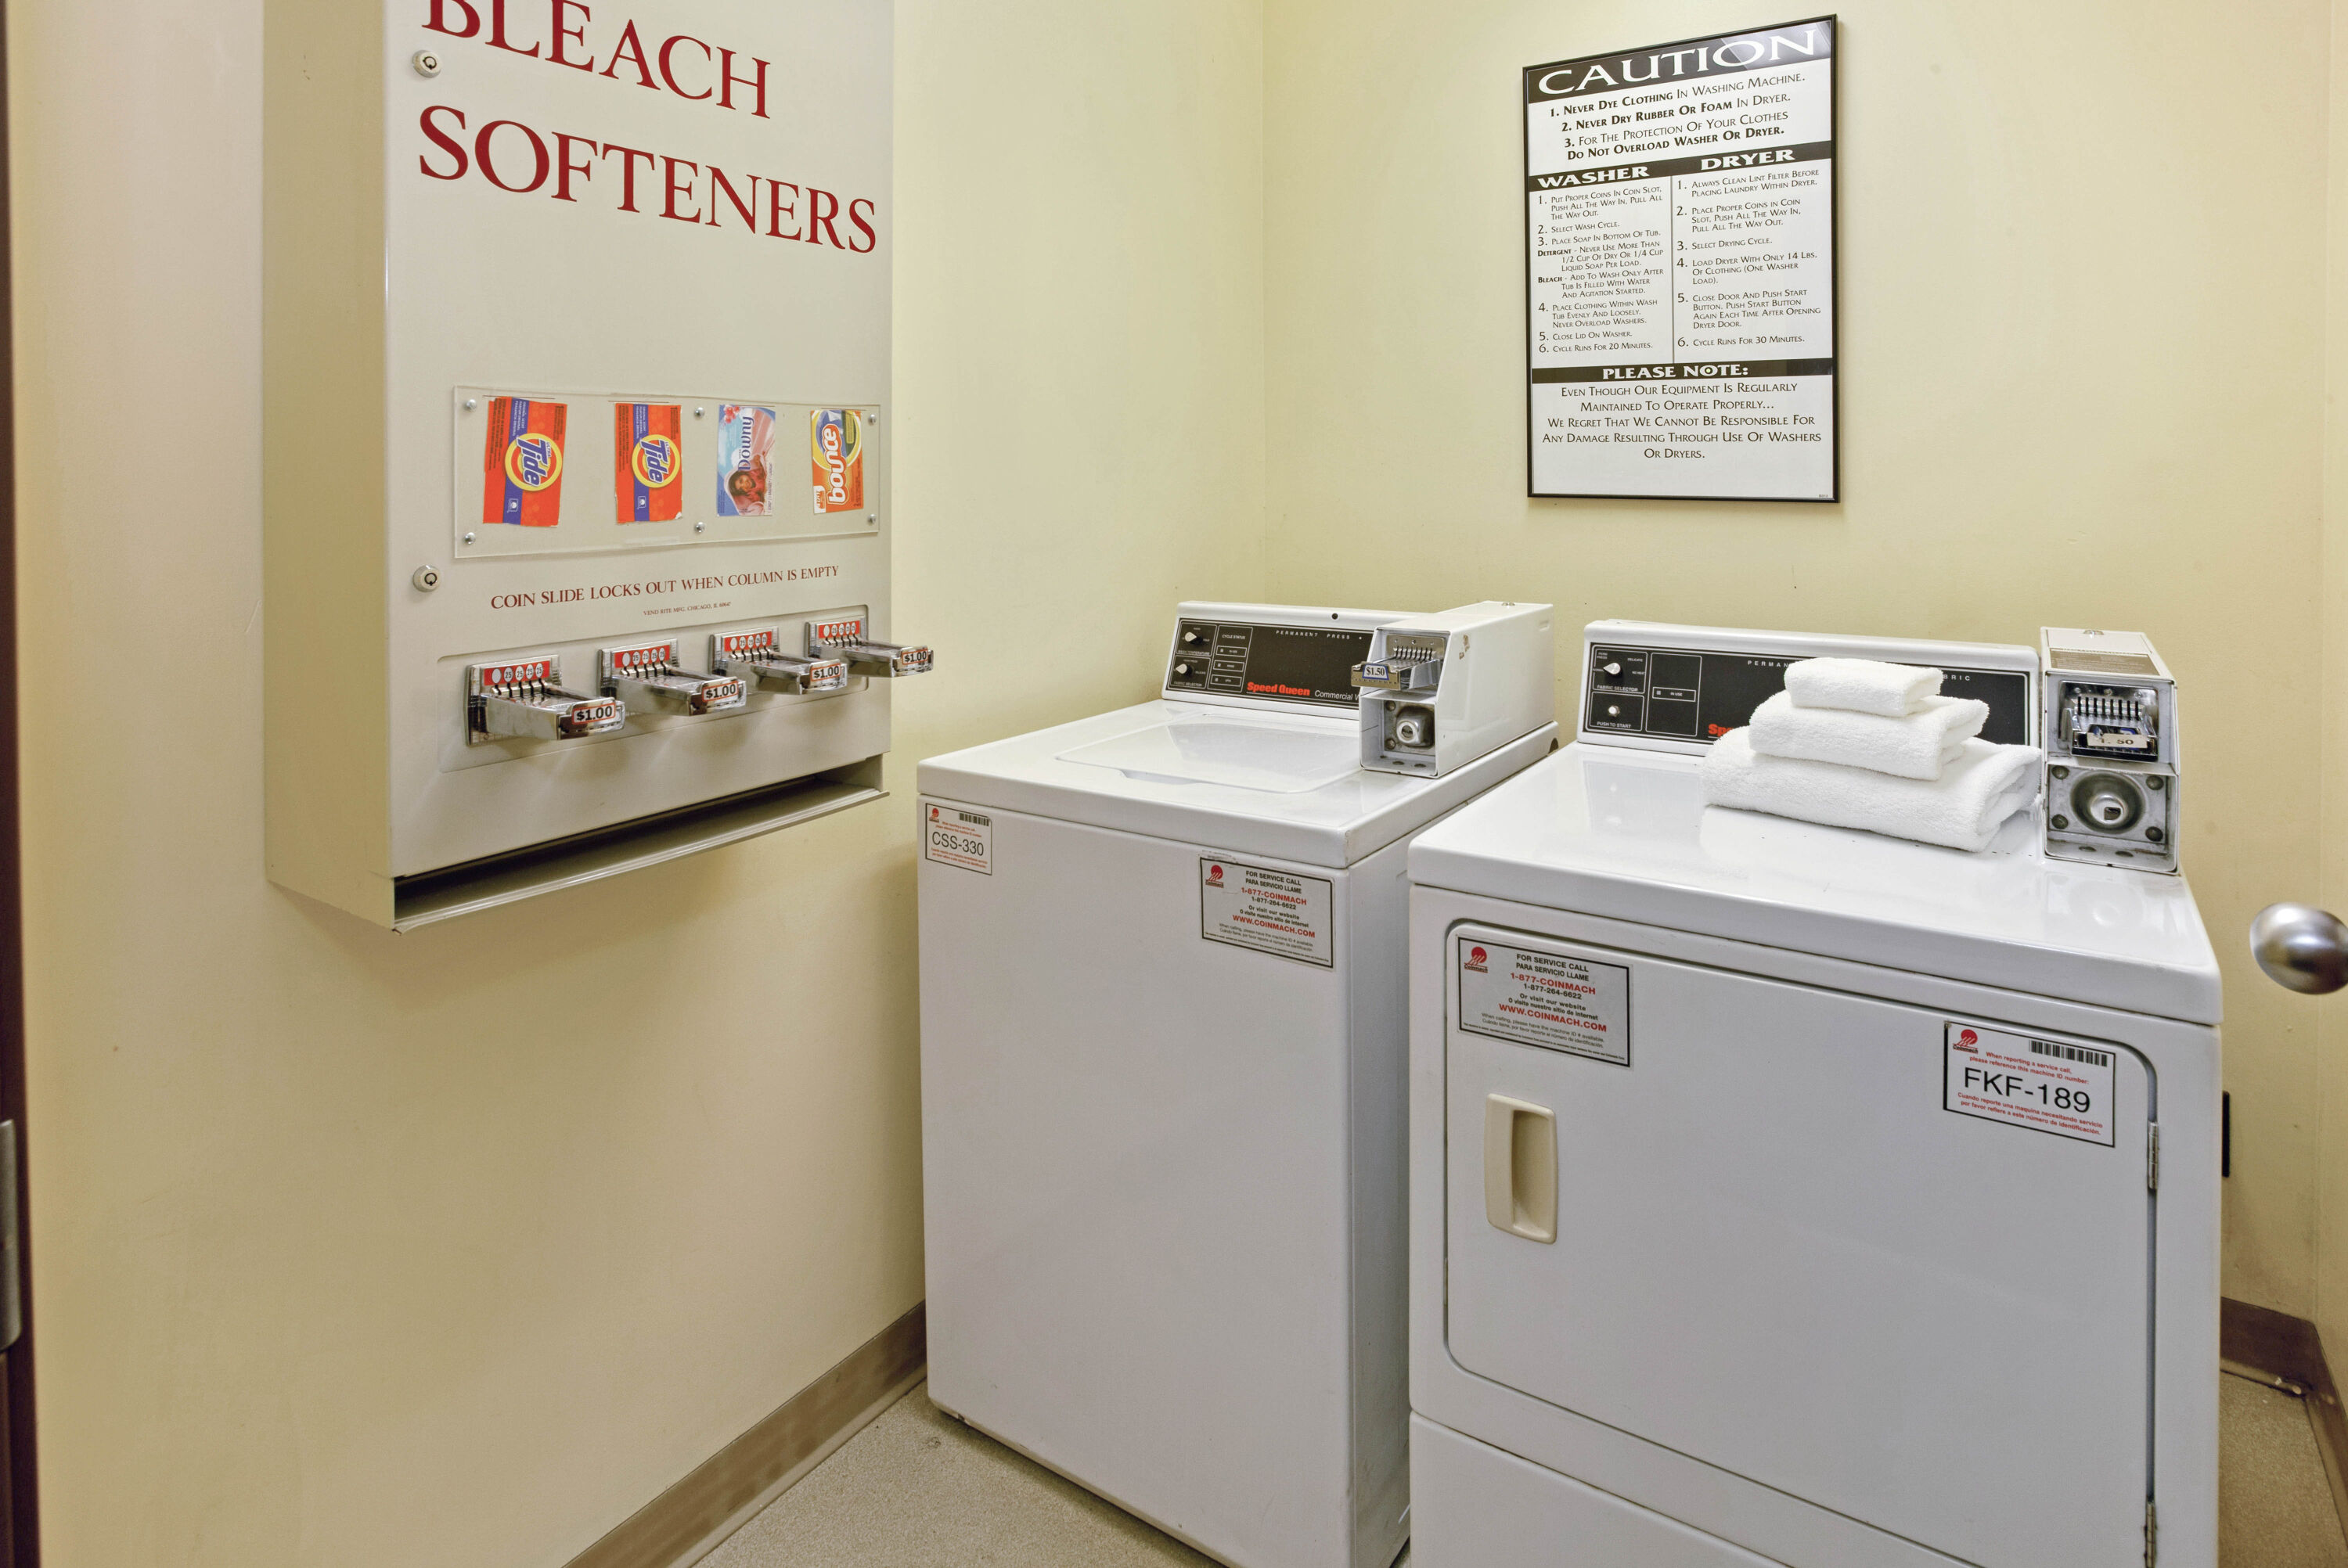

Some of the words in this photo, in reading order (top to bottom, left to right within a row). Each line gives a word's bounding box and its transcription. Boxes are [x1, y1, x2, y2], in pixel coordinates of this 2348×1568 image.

[421, 0, 771, 119] BLEACH
[1539, 29, 1817, 95] CAUTION
[1550, 107, 1560, 117] 1.
[1563, 103, 1595, 116] NEVER
[1597, 99, 1618, 110] DYE
[1621, 92, 1673, 106] CLOTHING
[1676, 88, 1688, 99] IN
[1691, 81, 1745, 96] WASHING
[1747, 74, 1806, 88] MACHINE.
[1561, 121, 1572, 132] 2.
[1576, 118, 1608, 130] NEVER
[1611, 114, 1632, 125] DRY
[1635, 109, 1675, 121] RUBBER
[1678, 105, 1697, 115] OR
[1700, 101, 1733, 113] FOAM
[1737, 98, 1748, 108] IN
[1752, 93, 1791, 106] DRYER.
[1564, 137, 1576, 148] 3.
[1578, 135, 1598, 146] FOR
[1600, 132, 1619, 143] THE
[1622, 125, 1683, 140] PROTECTION
[1686, 120, 1702, 132] OF
[1705, 118, 1737, 129] YOUR
[1739, 111, 1789, 125] CLOTHES
[1567, 150, 1585, 160] DO
[1587, 147, 1610, 158] NOT
[1612, 140, 1670, 154] OVERLOAD
[1673, 134, 1719, 146] WASHER
[1722, 130, 1741, 141] OR
[1745, 126, 1785, 138] DRYER.
[1701, 149, 1795, 171] DRYER
[419, 105, 876, 254] SOFTENERS
[1537, 166, 1650, 189] WASHER
[1539, 195, 1547, 205] 1.
[1677, 293, 1688, 303] 5.
[1603, 365, 1676, 380] PLEASE
[1684, 364, 1748, 378] NOTE:
[1561, 387, 1586, 397] EVEN
[1588, 386, 1631, 397] THOUGH
[1633, 384, 1658, 395] OUR
[1661, 383, 1720, 396] EQUIPMENT
[1723, 383, 1734, 393] IS
[1737, 382, 1798, 393] REGULARLY
[1579, 401, 1643, 412] MAINTAINED
[1644, 400, 1661, 411] TO
[1663, 400, 1709, 411] OPERATE
[1547, 418, 1565, 428] WE
[1568, 417, 1601, 427] REGRET
[1604, 417, 1630, 427] THAT
[1633, 416, 1651, 426] WE
[1654, 415, 1699, 426] CANNOT
[1702, 415, 1716, 426] BE
[1720, 415, 1789, 426] RESPONSIBLE
[1792, 414, 1816, 425] FOR
[738, 416, 755, 471] Downy
[1542, 433, 1564, 443] ANY
[1566, 433, 1610, 443] DAMAGE
[1613, 432, 1666, 443] RESULTING
[1667, 432, 1719, 442] THROUGH
[1722, 431, 1744, 442] USE
[1747, 431, 1764, 442] OF
[1767, 431, 1822, 442] WASHERS
[517, 437, 548, 487] Tide
[639, 439, 668, 484] Tide
[1643, 448, 1661, 459] OR
[1664, 448, 1705, 459] DRYERS.
[823, 427, 845, 503] bounce
[490, 592, 536, 610] COIN
[540, 588, 585, 605] SLIDE
[589, 582, 642, 599] LOCKS
[644, 580, 677, 594] OUT
[680, 576, 724, 590] WHEN
[727, 570, 783, 587] COLUMN
[787, 569, 798, 581] IS
[800, 565, 839, 580] EMPTY
[904, 651, 927, 663] $1.00
[504, 670, 513, 679] 25
[517, 669, 524, 678] 25
[535, 666, 542, 675] 25
[813, 666, 840, 680] $1.00
[1366, 667, 1385, 676] $1.50
[705, 683, 737, 699] $1.00
[1247, 682, 1278, 693] Speed
[1278, 684, 1311, 696] Queen
[1314, 689, 1353, 701] Commercial
[576, 705, 613, 721] $1.00
[932, 831, 984, 856] CSS-330
[1259, 872, 1284, 883] SERVICE
[1285, 877, 1302, 886] CALL
[1241, 886, 1307, 905] 1-877-COINMACH
[1232, 914, 1316, 938] WWW.COINMACH.COM
[1515, 962, 1533, 971] PARA
[1534, 966, 1565, 977] SERVICIO
[1566, 971, 1589, 982] LLAME
[1516, 953, 1532, 962] FOR
[1533, 956, 1567, 969] SERVICE
[1568, 962, 1589, 973] CALL
[1510, 972, 1596, 995] 1-877-COINMACH
[1523, 983, 1583, 1000] 1-877-264-6622
[1498, 1003, 1607, 1033] WWW.COINMACH.COM
[1964, 1067, 2091, 1113] FKF-189
